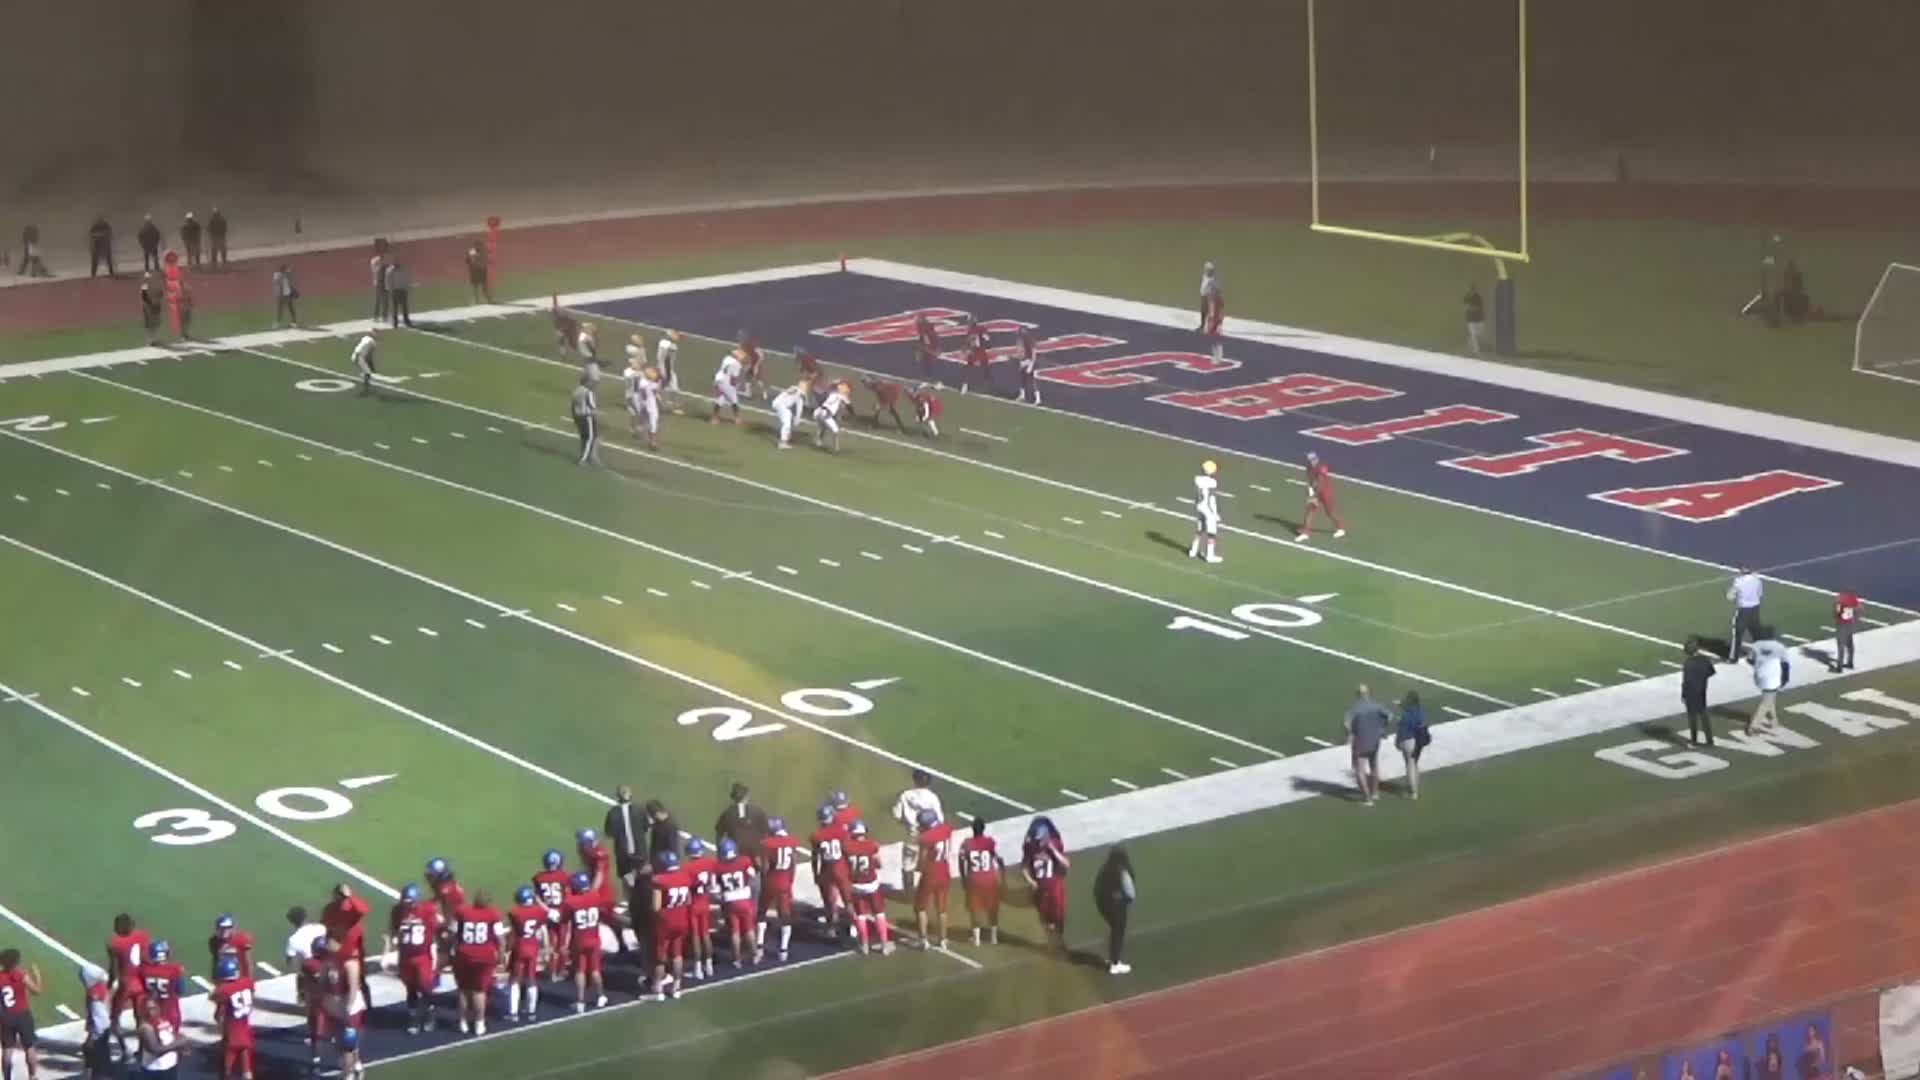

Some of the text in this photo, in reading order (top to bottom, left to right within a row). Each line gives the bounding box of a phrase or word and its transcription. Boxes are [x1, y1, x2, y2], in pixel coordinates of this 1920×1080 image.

[808, 307, 1842, 522] WICHITA
[1166, 602, 1323, 640] 10
[677, 687, 874, 740] 20
[133, 786, 354, 845] 30
